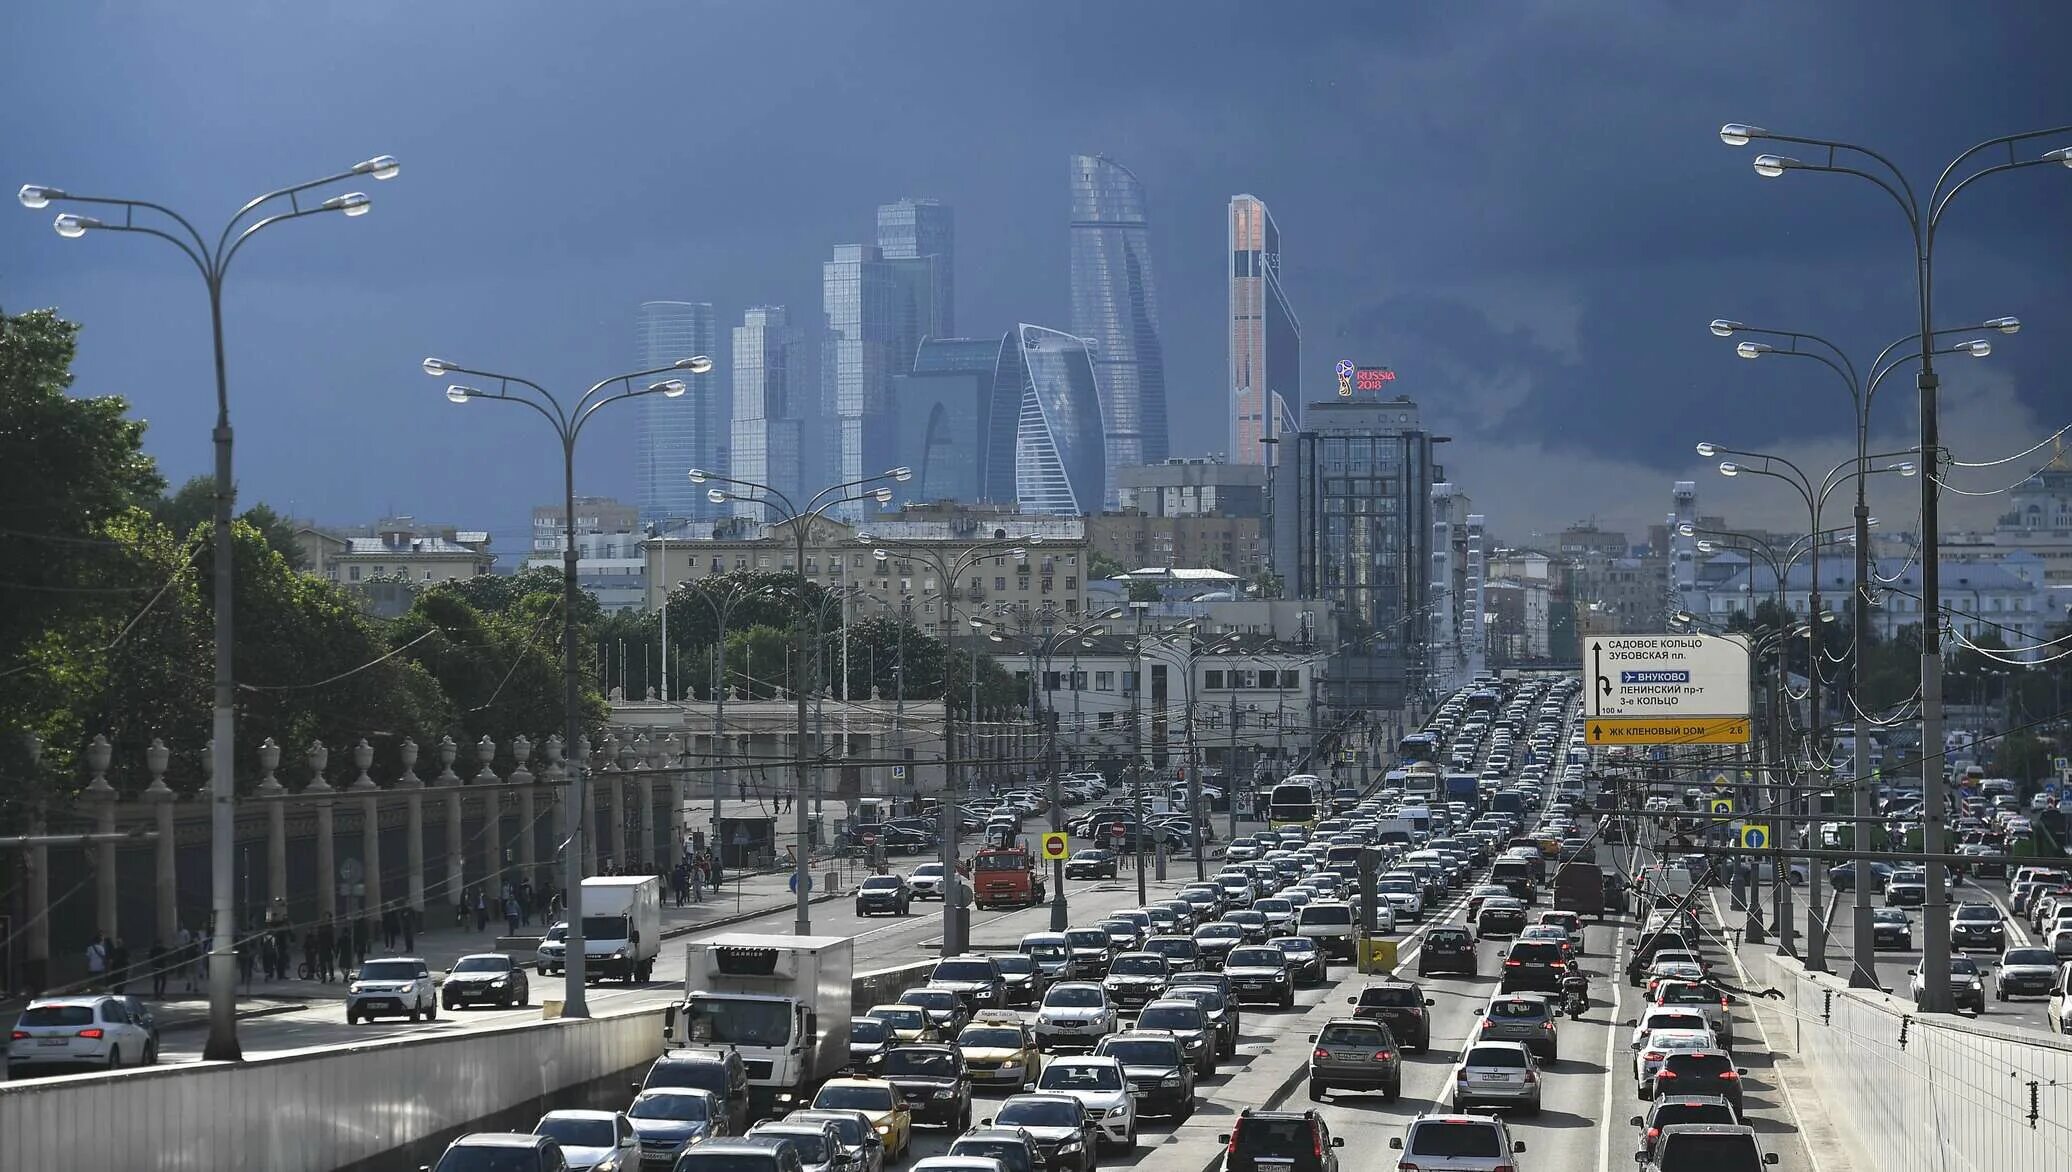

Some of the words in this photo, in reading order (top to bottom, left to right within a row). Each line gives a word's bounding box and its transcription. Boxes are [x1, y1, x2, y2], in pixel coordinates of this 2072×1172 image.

[1357, 370, 1396, 380] RUSSIA
[1357, 380, 1382, 390] 2018
[1608, 640, 1658, 649] САДОВОЕ
[1660, 639, 1703, 649] КОЛЬЦО
[1608, 651, 1669, 660] ЗУБОВСКАЯ
[1638, 672, 1686, 681] ВНУКОВО
[1620, 684, 1681, 694] ЛЕНИНСКИЙ
[1684, 687, 1704, 695] пр-т
[1620, 697, 1634, 706] 3-е
[1637, 697, 1679, 706] КОЛЬЦО
[1609, 728, 1625, 736] ЖК
[1626, 727, 1681, 736] КЛЕНОВЫЙ
[1729, 727, 1743, 735] 2.6
